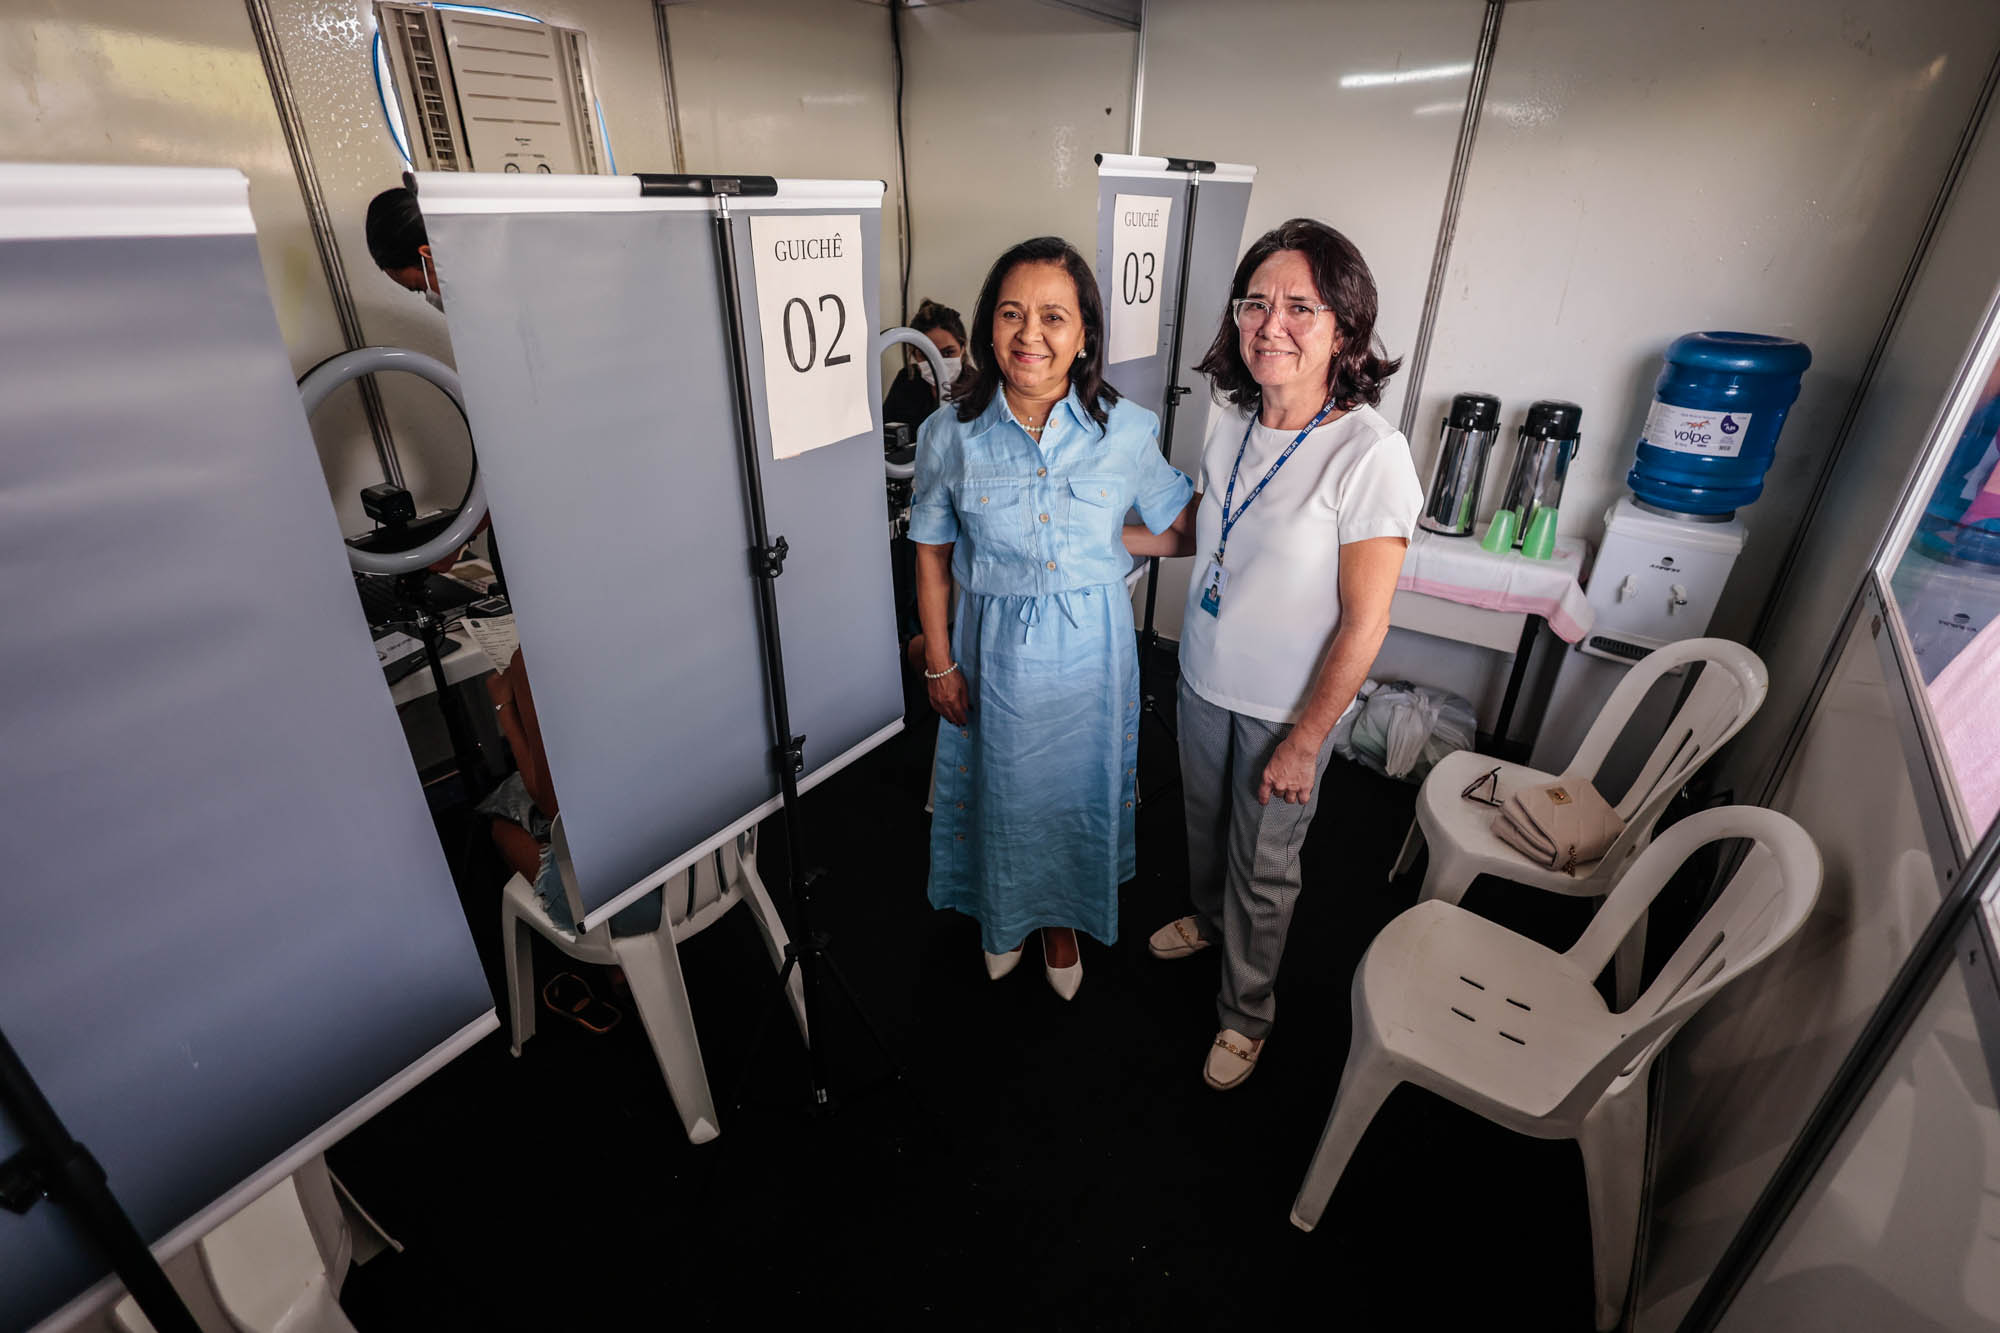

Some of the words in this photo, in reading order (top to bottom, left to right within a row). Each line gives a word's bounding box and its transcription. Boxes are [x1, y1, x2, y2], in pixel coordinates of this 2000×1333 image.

[1124, 209, 1159, 228] GUICHÊ
[774, 232, 843, 262] GUICHÊ
[1123, 251, 1155, 305] 03
[783, 294, 851, 373] 02
[1303, 418, 1319, 434] TRE-PI
[1674, 430, 1712, 445] volpe
[1283, 441, 1299, 458] TRE-PI
[1264, 463, 1280, 481] TRE-PI
[1247, 486, 1261, 502] TRE-PI
